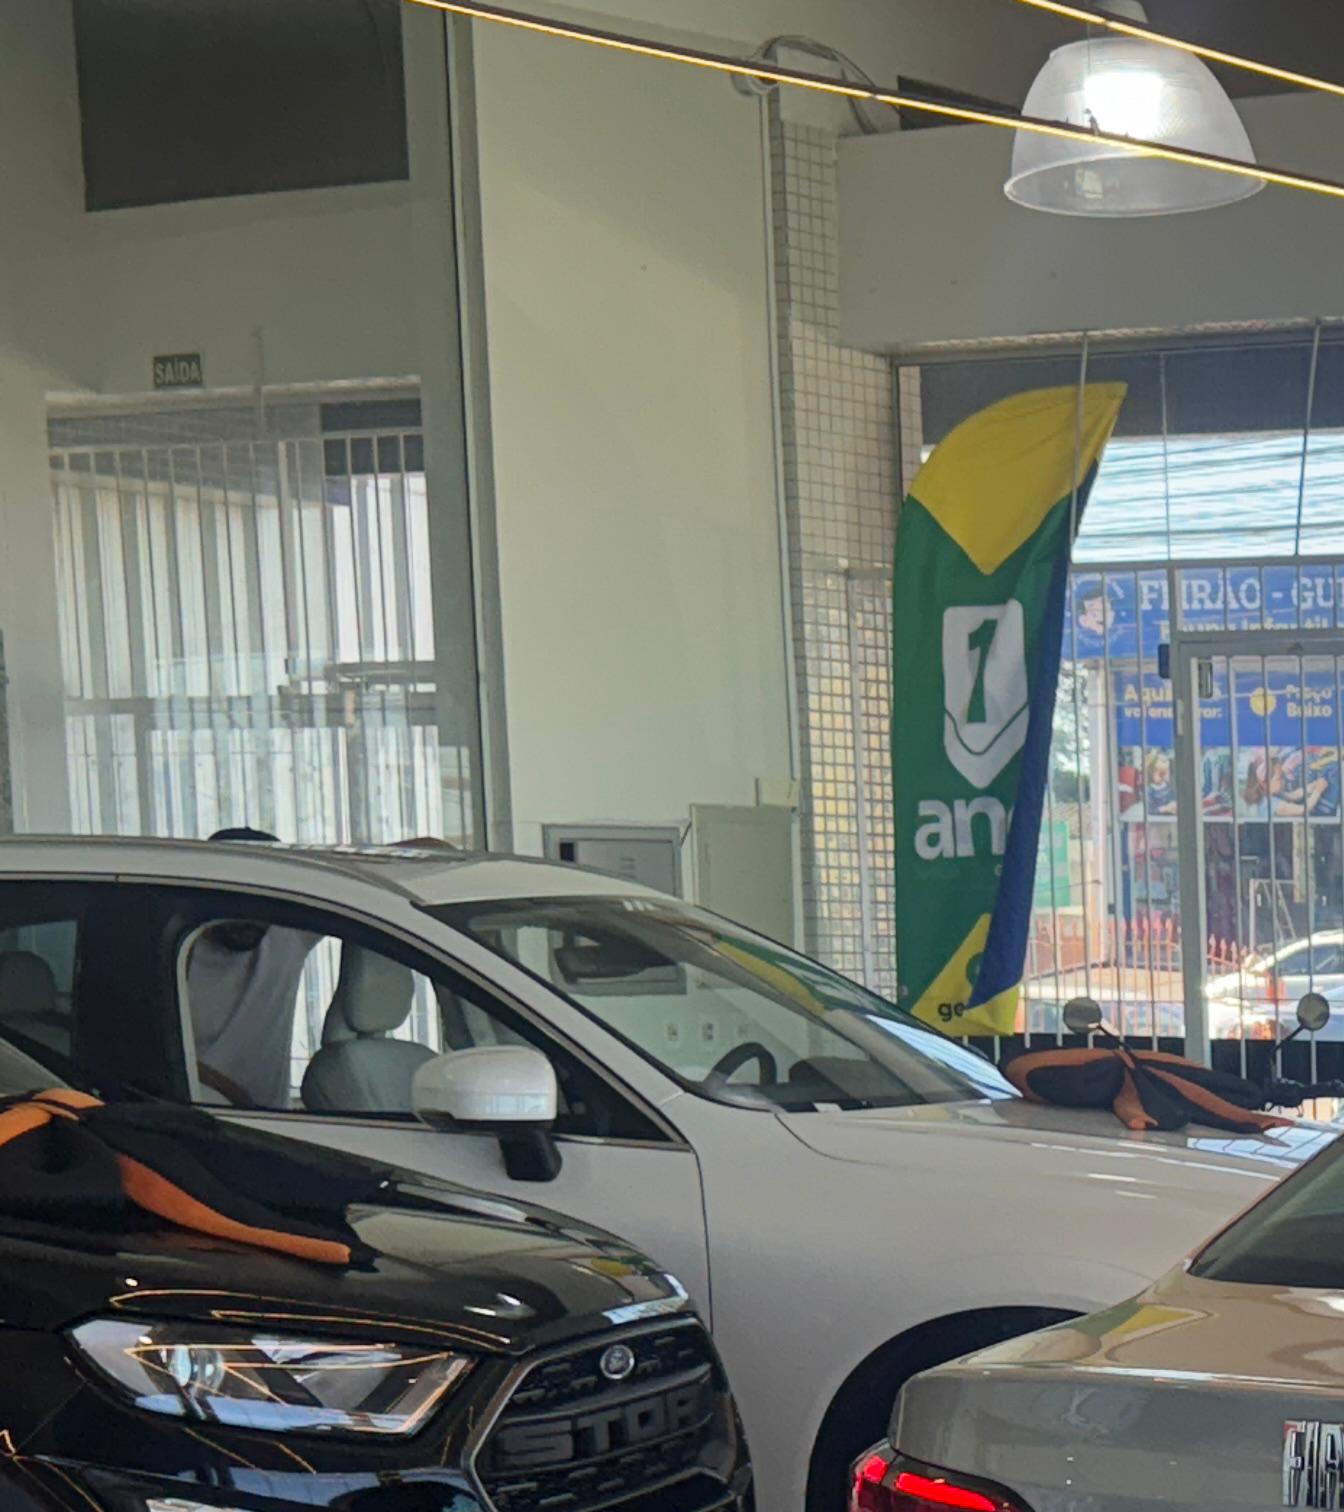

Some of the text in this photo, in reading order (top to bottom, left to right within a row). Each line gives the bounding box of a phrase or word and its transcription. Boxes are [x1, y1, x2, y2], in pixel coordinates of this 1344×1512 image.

[155, 357, 202, 385] SAÍDA
[967, 618, 999, 724] 1
[914, 796, 1015, 861] an
